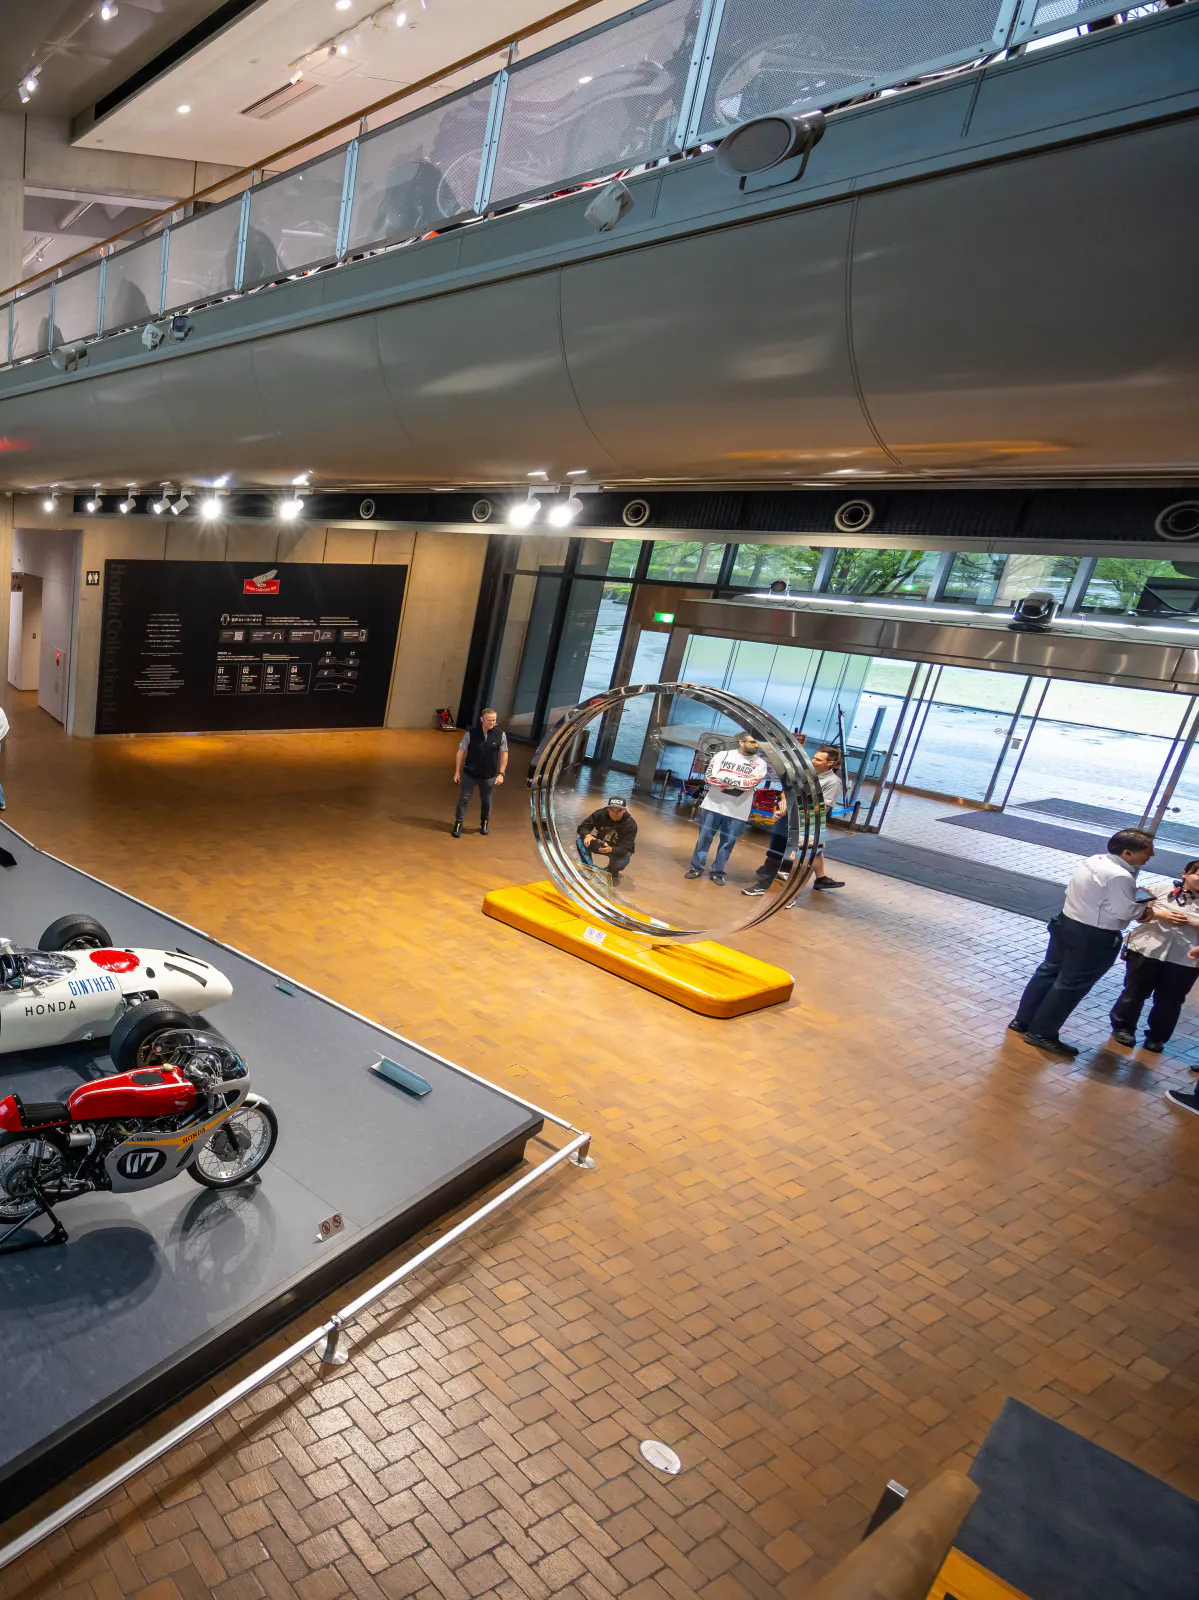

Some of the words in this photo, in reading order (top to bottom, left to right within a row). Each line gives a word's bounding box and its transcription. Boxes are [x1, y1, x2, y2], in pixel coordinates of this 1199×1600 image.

[108, 563, 126, 616] Honda
[103, 618, 122, 699] Collection
[67, 975, 116, 996] GINTHER
[25, 1000, 77, 1017] HONDA
[182, 1127, 206, 1144] HONDA
